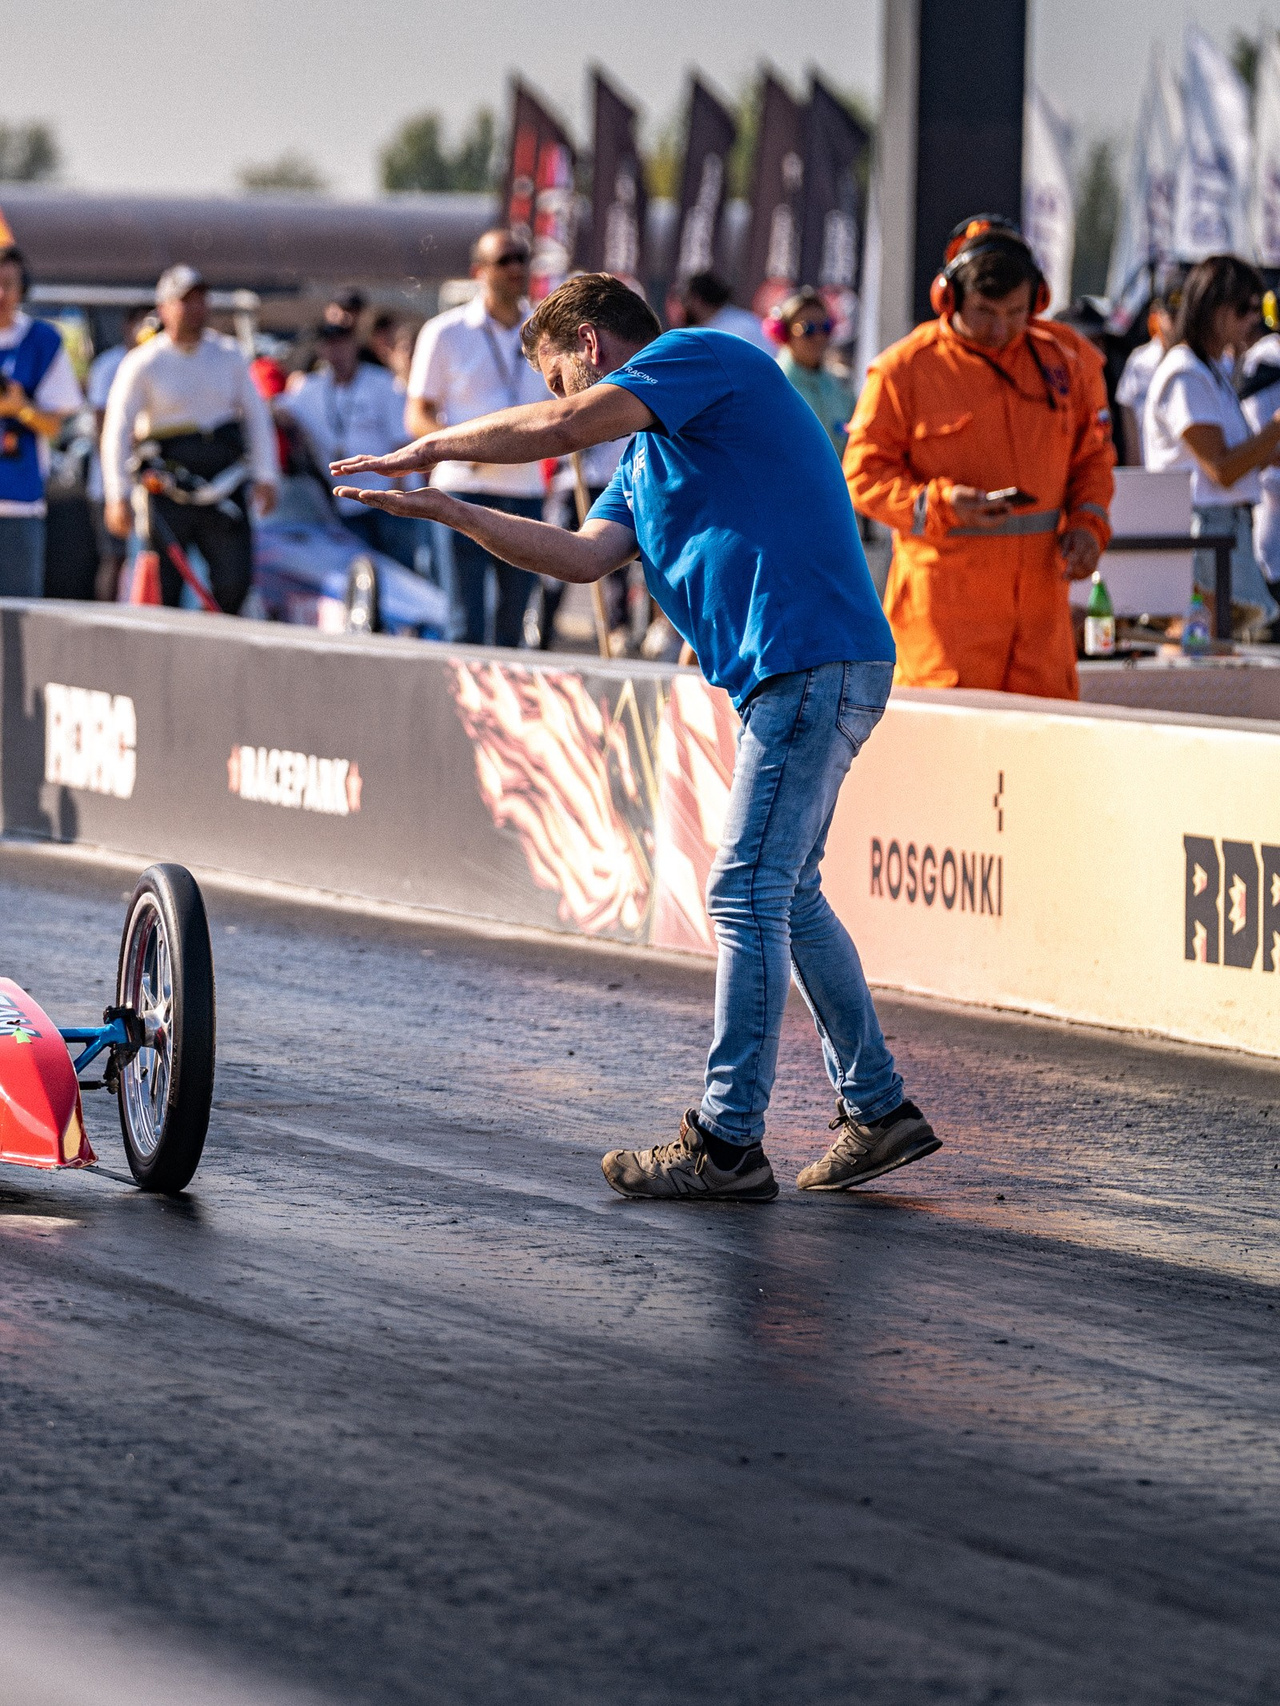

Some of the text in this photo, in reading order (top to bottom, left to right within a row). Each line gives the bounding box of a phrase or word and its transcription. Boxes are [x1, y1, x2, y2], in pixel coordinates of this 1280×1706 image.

[624, 365, 658, 384] RACING
[44, 681, 137, 800] RDRC
[239, 745, 350, 816] RACEPARK
[870, 836, 1003, 917] ROSGONKI
